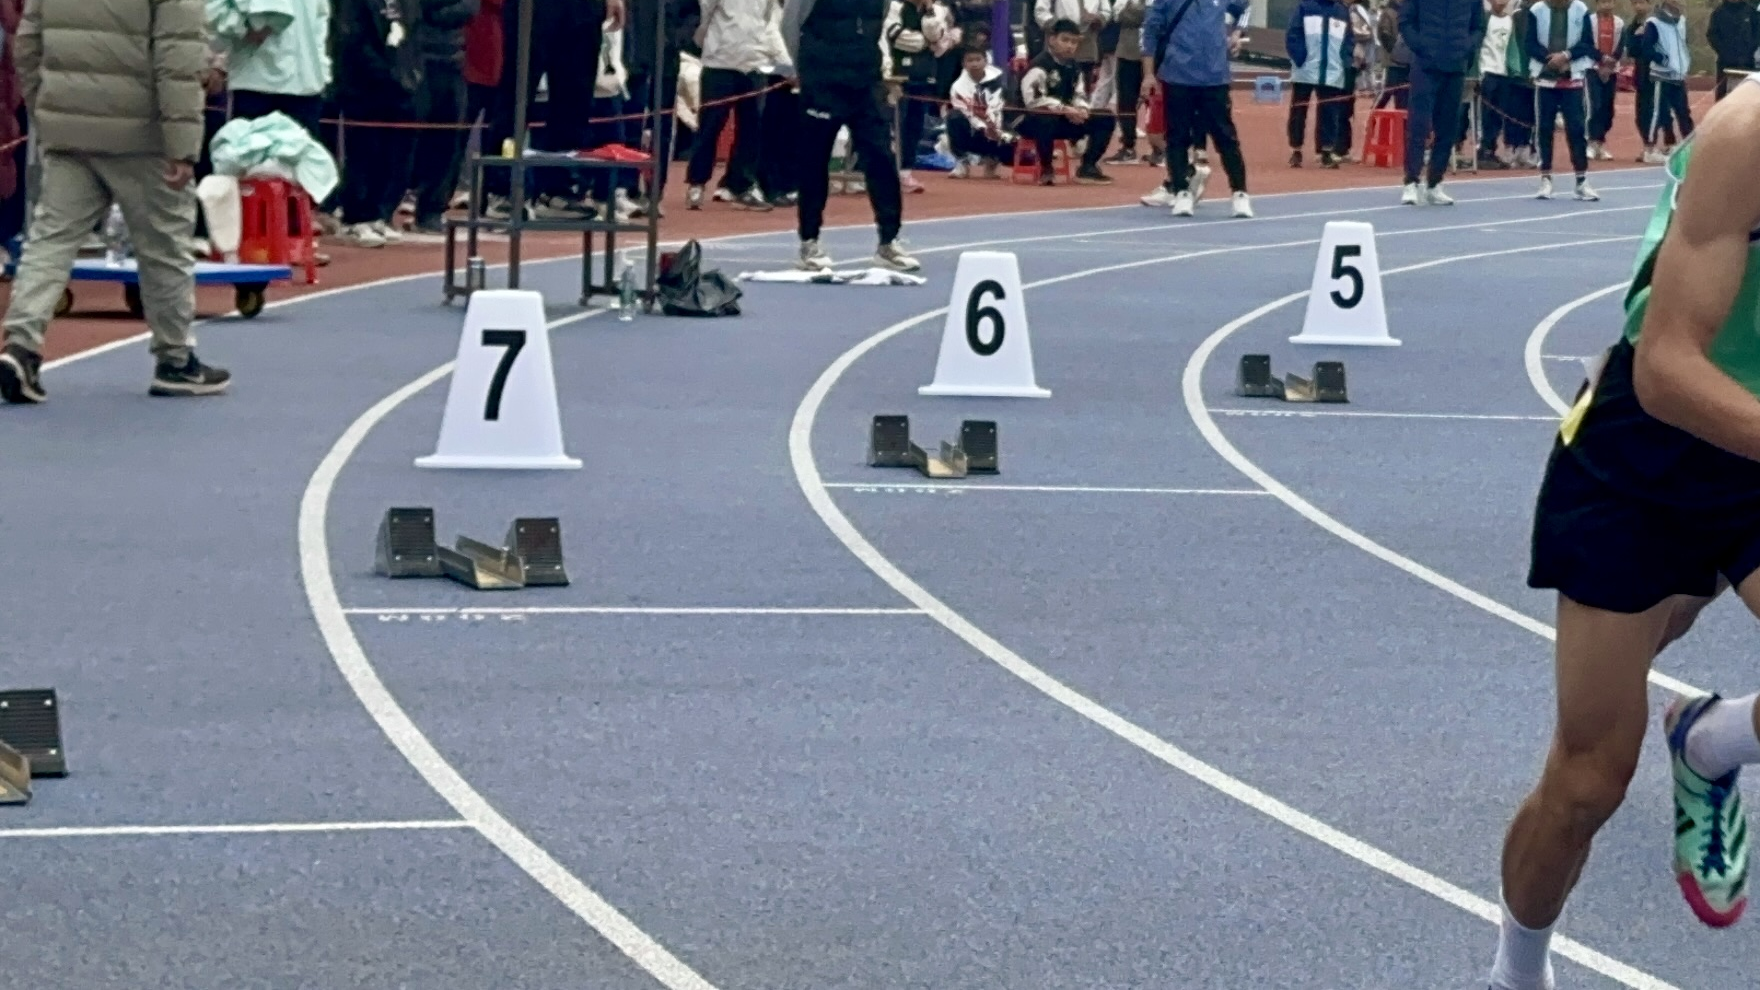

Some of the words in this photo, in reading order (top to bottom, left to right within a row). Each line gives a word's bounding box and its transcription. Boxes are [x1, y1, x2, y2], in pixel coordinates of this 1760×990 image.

[1329, 244, 1364, 309] 5
[965, 279, 1006, 357] 6
[481, 329, 527, 421] 7
